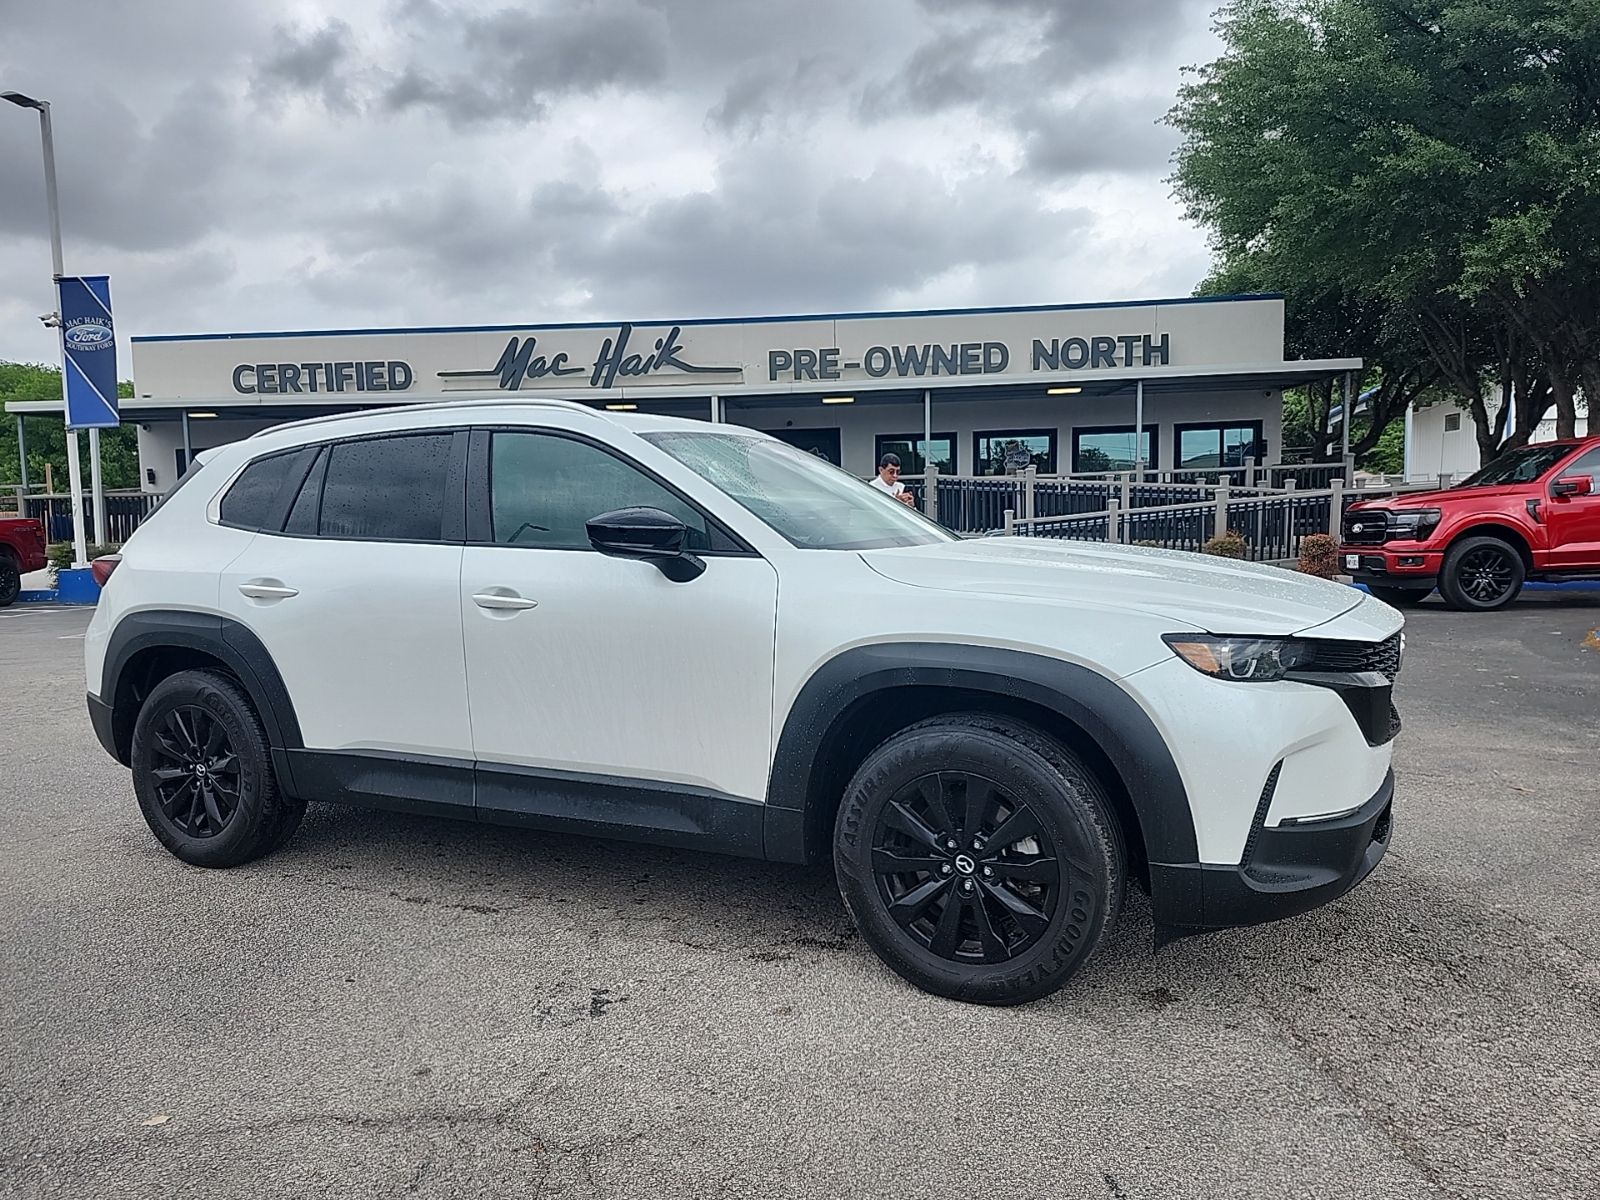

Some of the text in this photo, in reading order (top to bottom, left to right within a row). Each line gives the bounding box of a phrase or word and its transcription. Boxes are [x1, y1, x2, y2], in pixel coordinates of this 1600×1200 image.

[65, 317, 112, 329] MAC HAIK'S
[73, 328, 103, 342] Ford
[66, 341, 113, 351] SOUTHWAY FORD
[437, 324, 743, 391] Mac Haik
[767, 332, 1170, 382] PRE-OWNED NORTH
[232, 360, 414, 394] CERTIFIED
